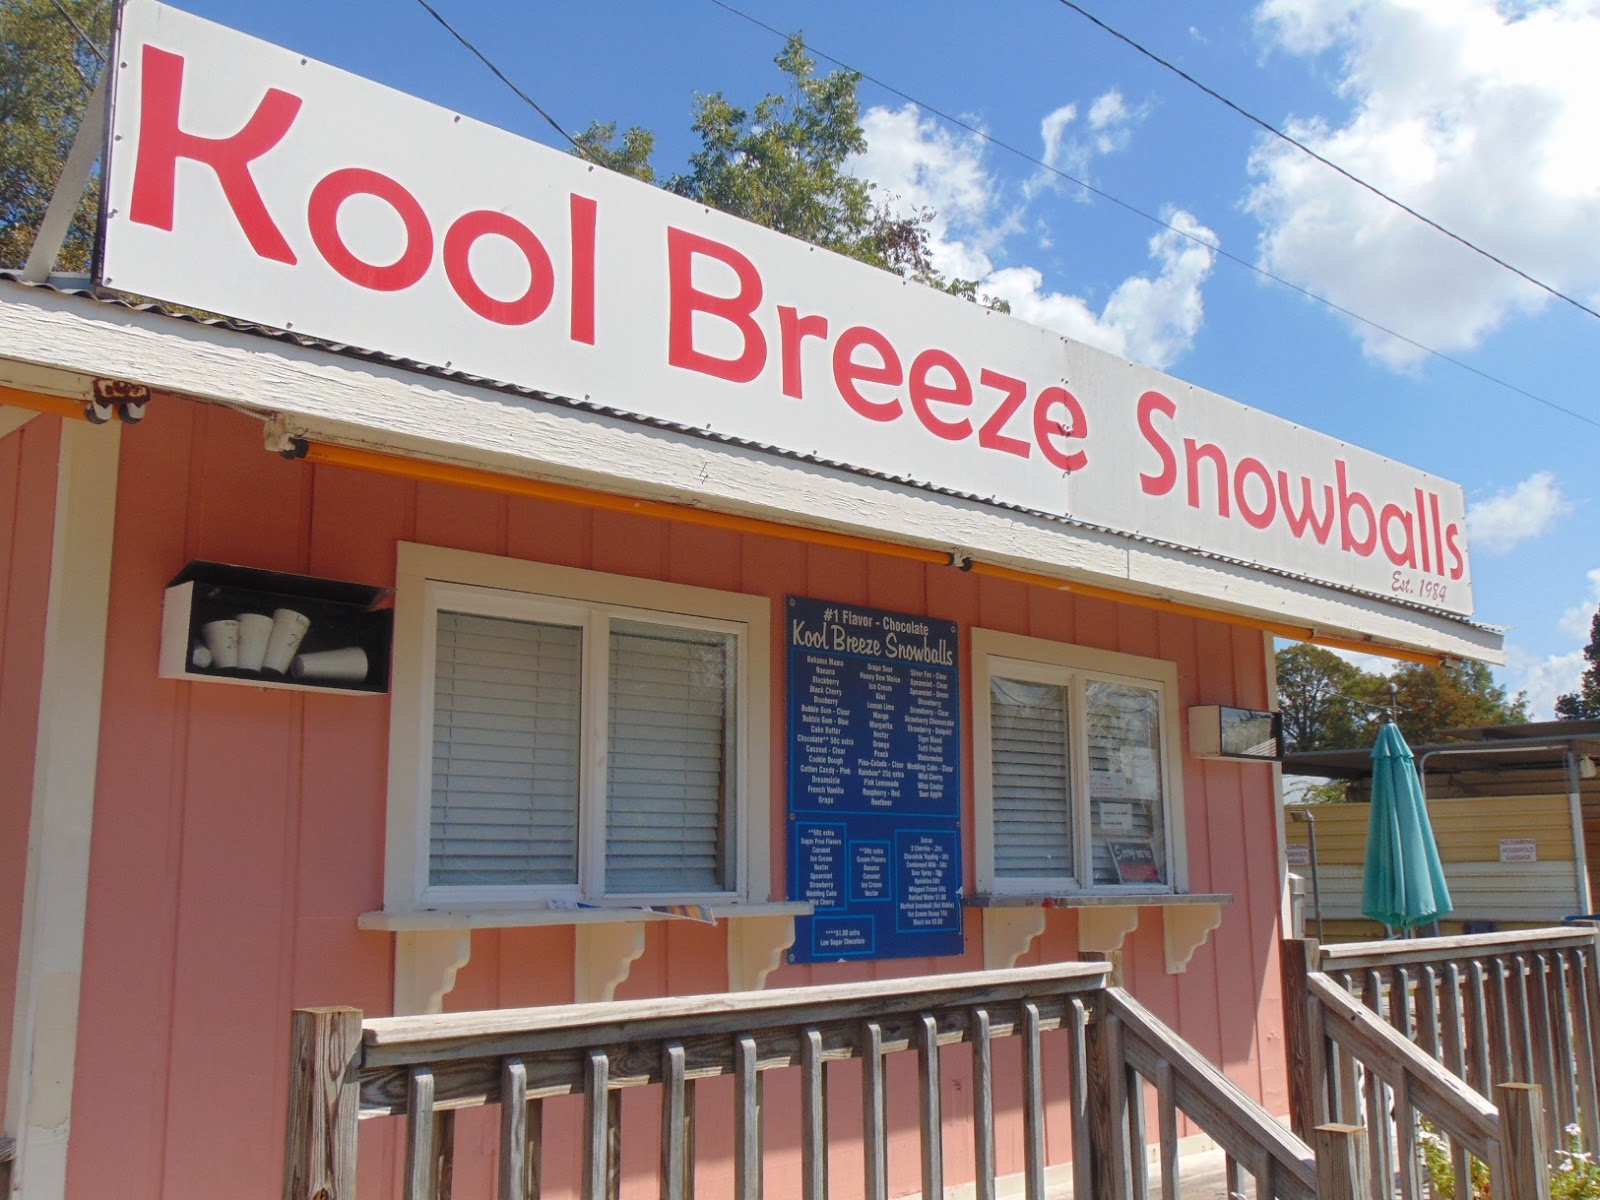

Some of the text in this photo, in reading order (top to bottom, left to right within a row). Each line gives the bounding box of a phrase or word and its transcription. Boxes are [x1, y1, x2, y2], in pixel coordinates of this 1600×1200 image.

[129, 43, 1464, 581] Kool Breeze Snowballs
[1391, 570, 1414, 594] Est.
[823, 608, 839, 622] #1
[842, 610, 873, 627] Flavor
[883, 616, 929, 636] Chocolate
[793, 619, 953, 666] Kool Breeze Snowballs
[807, 656, 844, 667] Bahama Mama
[816, 666, 835, 675] Banana
[867, 663, 881, 672] Grape
[813, 676, 839, 686] Blackberry
[860, 672, 874, 681] Honey
[810, 685, 842, 696] Black Cherry
[877, 684, 892, 692] Cream
[814, 696, 838, 706] Blueberry
[918, 698, 941, 708] Strawberry
[801, 705, 819, 713] Bubble
[884, 703, 894, 711] Lime
[802, 715, 820, 723] Bubble
[873, 711, 889, 721] Mango
[811, 725, 841, 735] Cake Batter
[869, 721, 893, 730] Margarita
[873, 731, 889, 739] Nectar
[806, 745, 827, 753] Coconut
[873, 740, 889, 749] Orange
[874, 750, 888, 758] Peach
[809, 755, 843, 765] Cookie Dough
[800, 765, 851, 775] Cotton Candy Pink
[812, 775, 840, 784] Dreamsicle
[864, 778, 899, 787] Pink Lemonade
[808, 785, 825, 793] French
[863, 788, 886, 797] Raspberry
[819, 796, 834, 805] Grape
